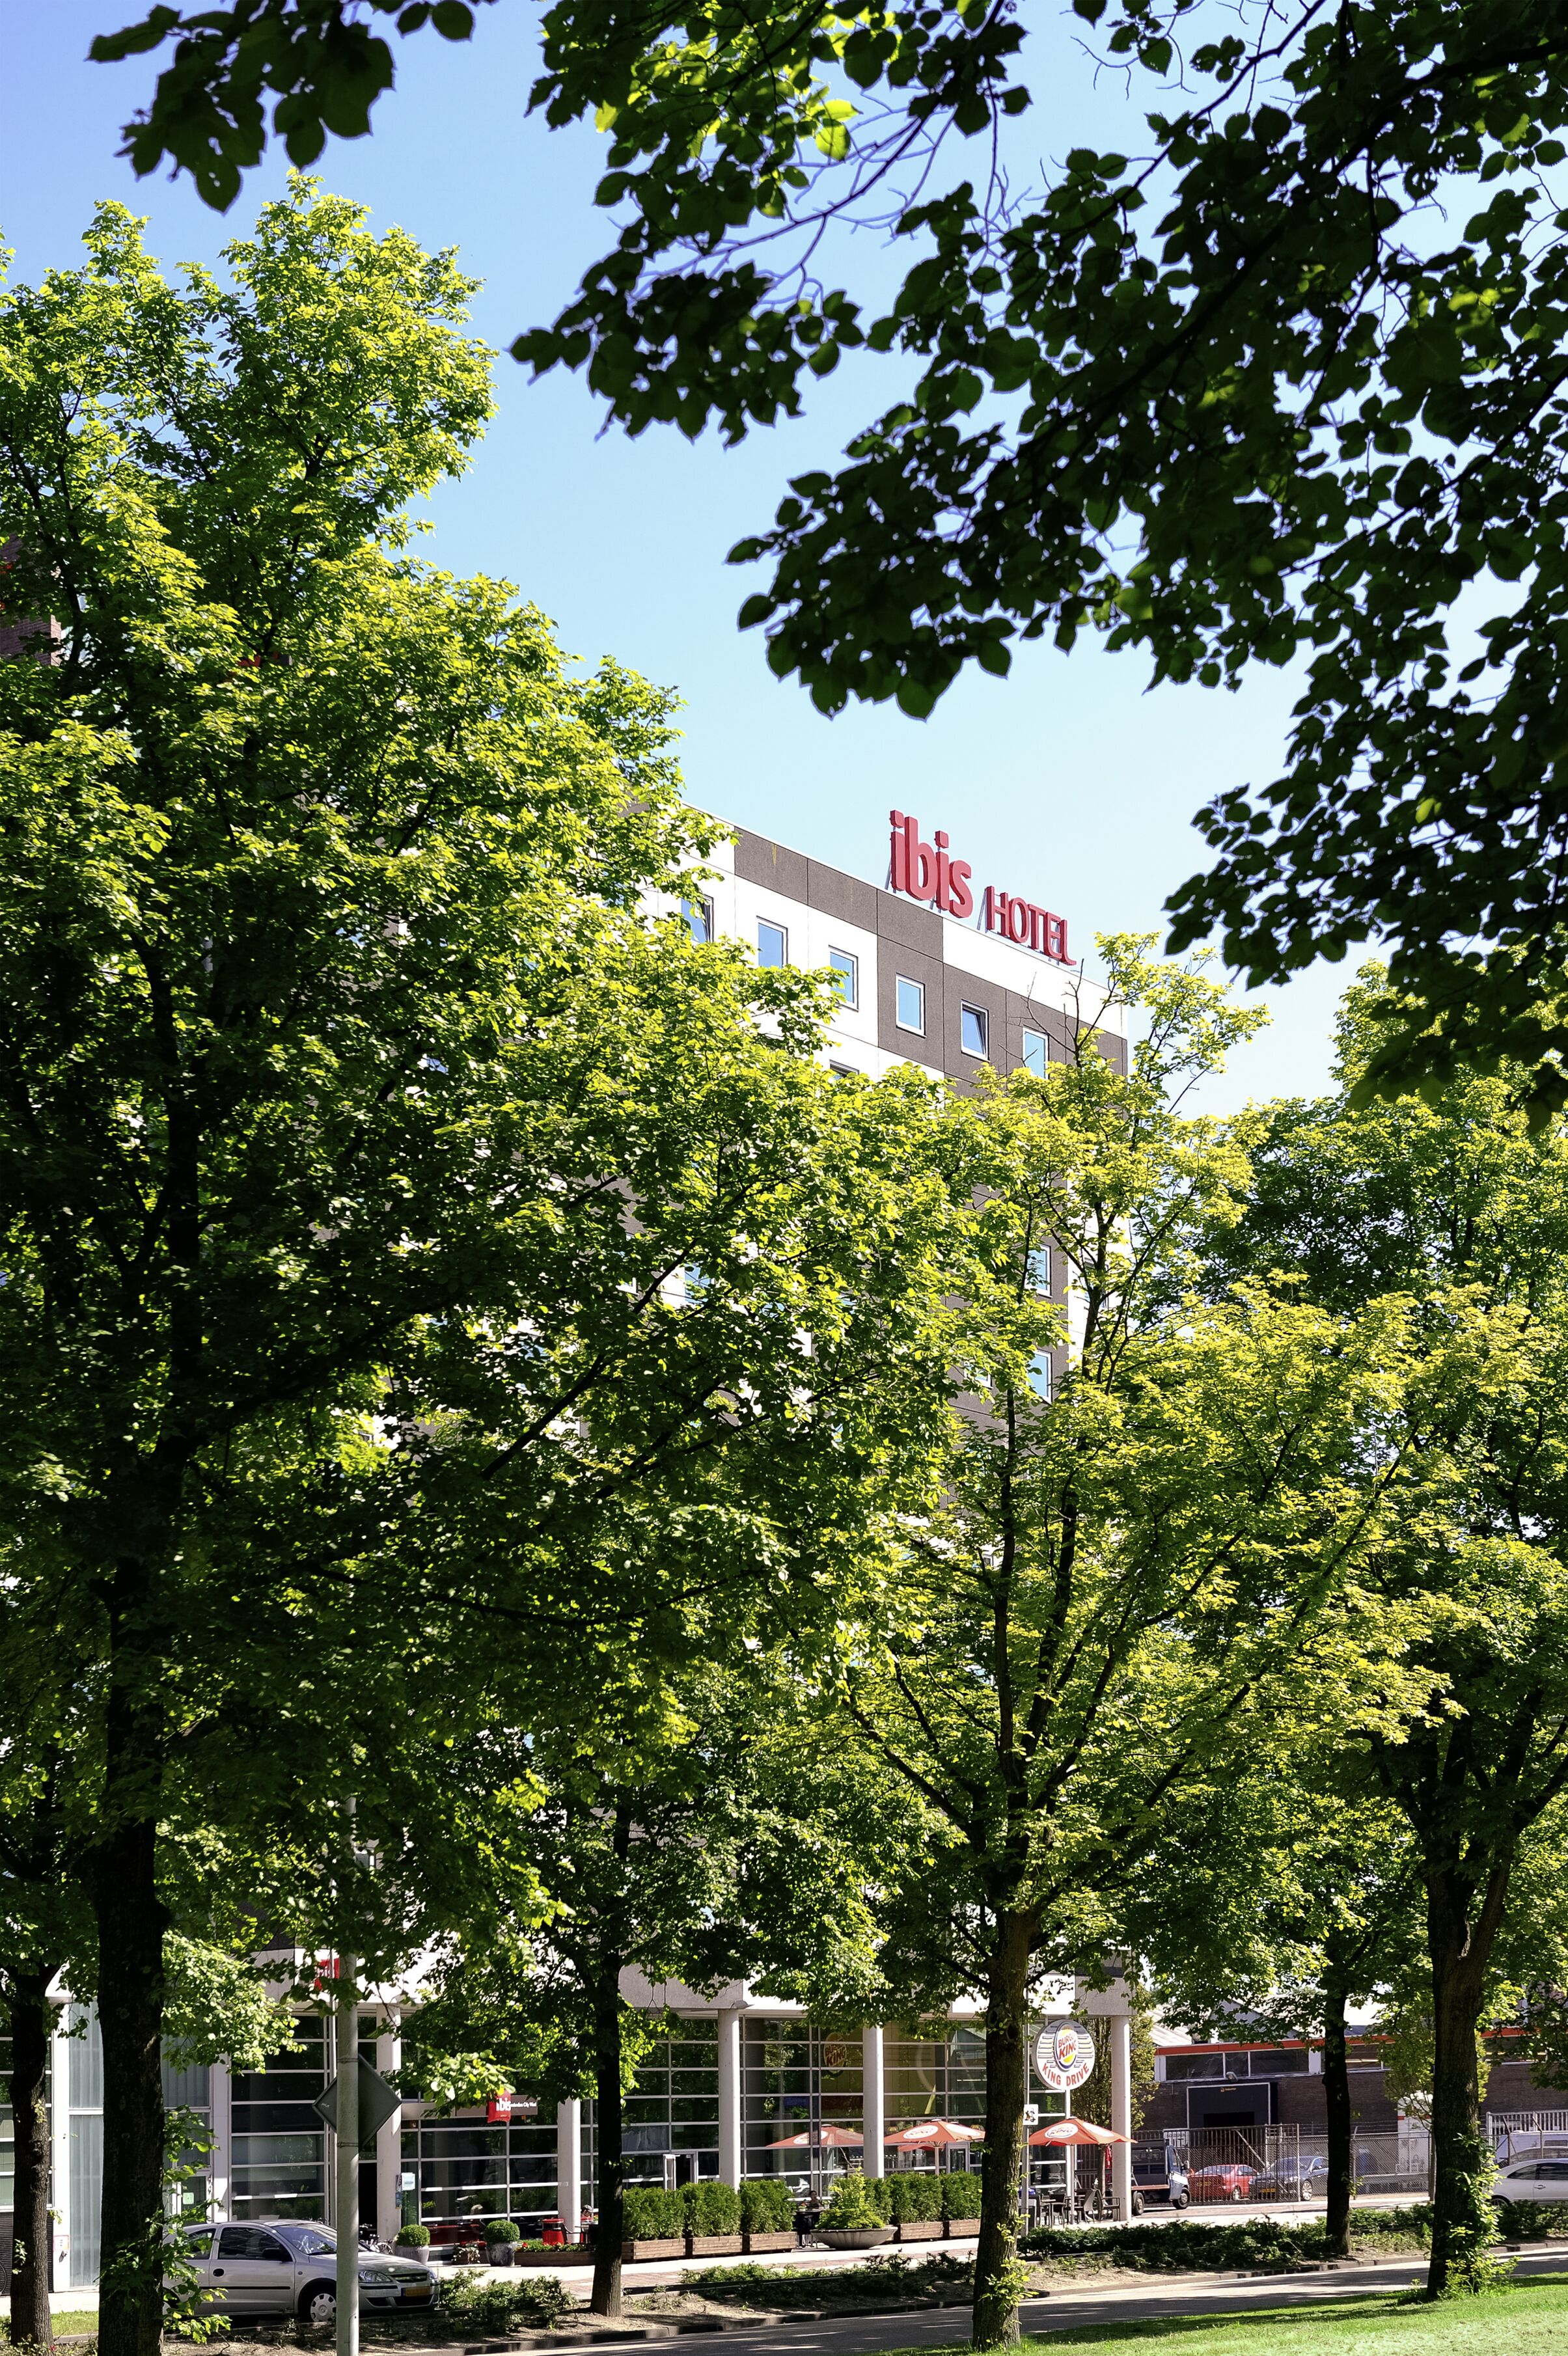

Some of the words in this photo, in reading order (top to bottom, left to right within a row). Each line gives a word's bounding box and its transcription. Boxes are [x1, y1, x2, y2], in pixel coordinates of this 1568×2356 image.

[890, 810, 973, 918] ibis
[986, 886, 1077, 966] HOTEL
[1058, 2040, 1077, 2060] KING
[1042, 2062, 1062, 2085] KING
[1066, 2062, 1090, 2087] DRIVE
[496, 2097, 511, 2111] ibis
